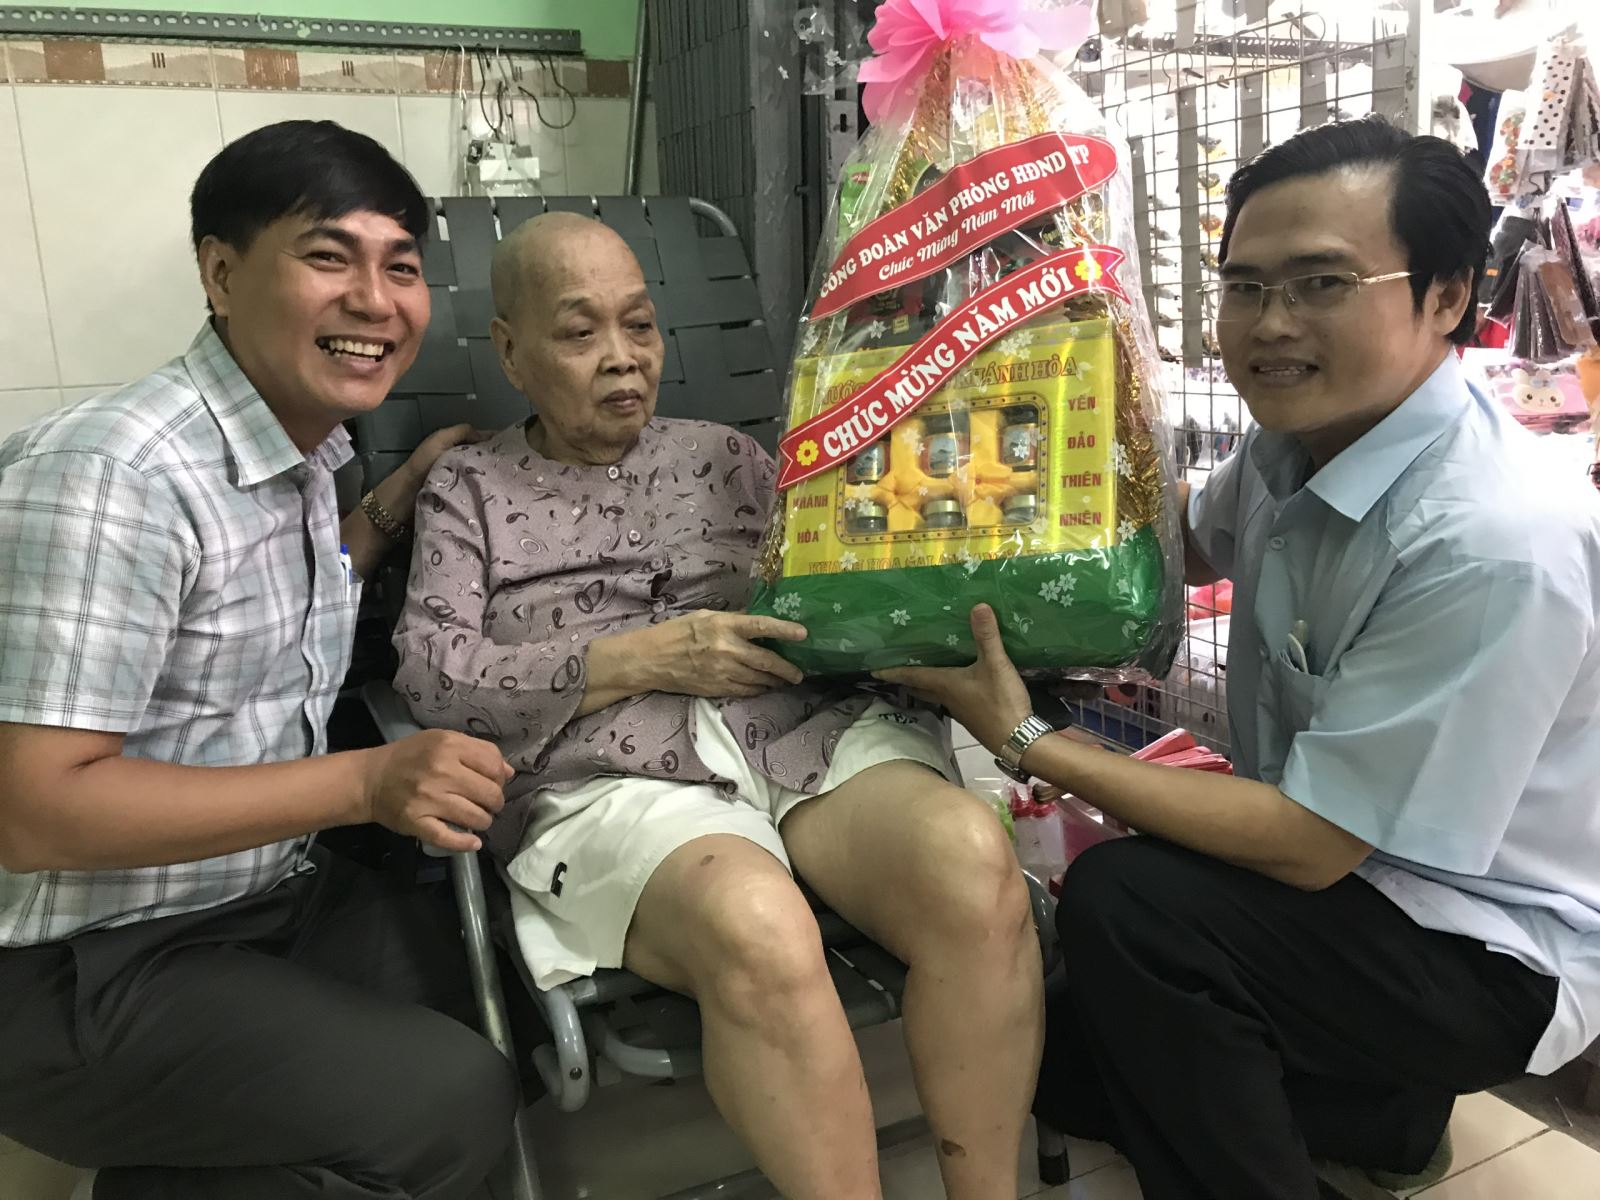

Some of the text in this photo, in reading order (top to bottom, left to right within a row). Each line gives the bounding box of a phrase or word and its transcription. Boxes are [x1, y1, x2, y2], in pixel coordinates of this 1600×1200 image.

[820, 144, 1089, 298] CÔNG ĐOÀN VĂN PHÒNG HĐND TP
[879, 190, 1036, 280] Chúc Mừng Năm Mới
[823, 267, 1075, 457] CHÚC MỪNG NĂM MỚI
[1031, 353, 1077, 379] HÒA
[1061, 472, 1101, 488] THIÊN
[1059, 510, 1102, 527] NHIÊN
[797, 528, 819, 544] HÒA
